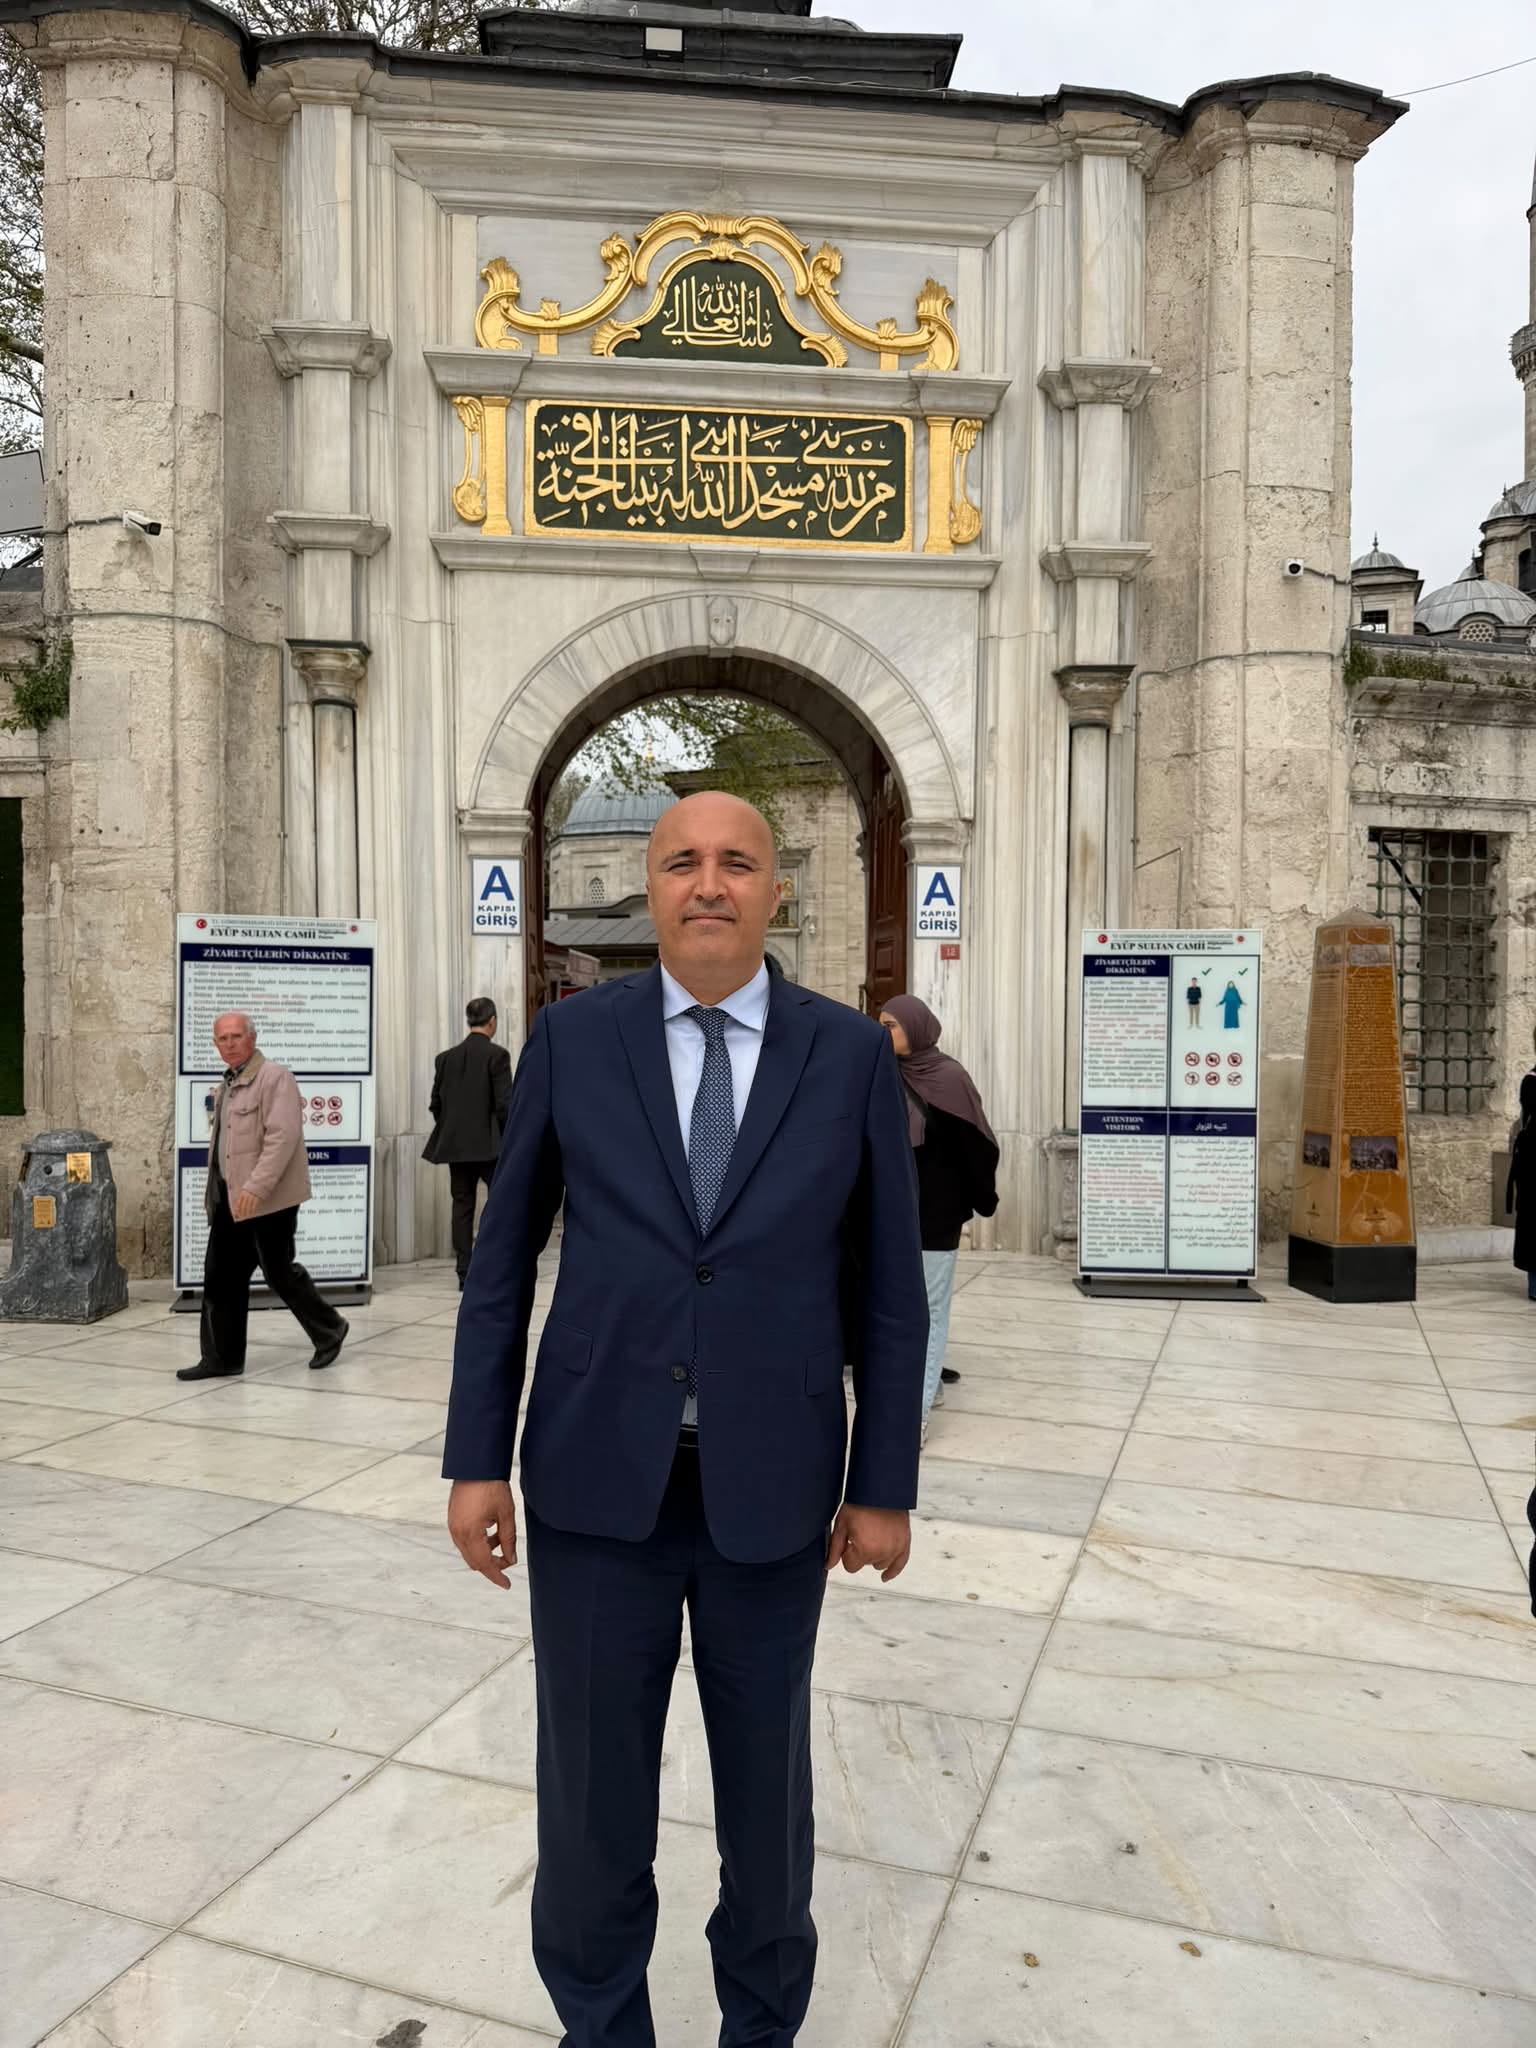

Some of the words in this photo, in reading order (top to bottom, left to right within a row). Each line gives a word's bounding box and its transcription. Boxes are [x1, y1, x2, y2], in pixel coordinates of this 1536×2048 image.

[480, 865, 515, 901] A
[923, 872, 955, 906] A
[476, 912, 518, 928] GİRİŞ
[919, 917, 958, 932] GİRİŞ
[210, 926, 239, 937] EYÜP
[241, 928, 282, 939] SULTAN
[1110, 940, 1136, 950] EYÜP
[1137, 942, 1174, 950] SULTAN
[202, 947, 291, 960] ZİYARETÇİLERİN
[293, 949, 351, 961] DİKKATİNE
[1102, 1116, 1145, 1124] ATTENTION
[1105, 1123, 1141, 1132] VISITORS
